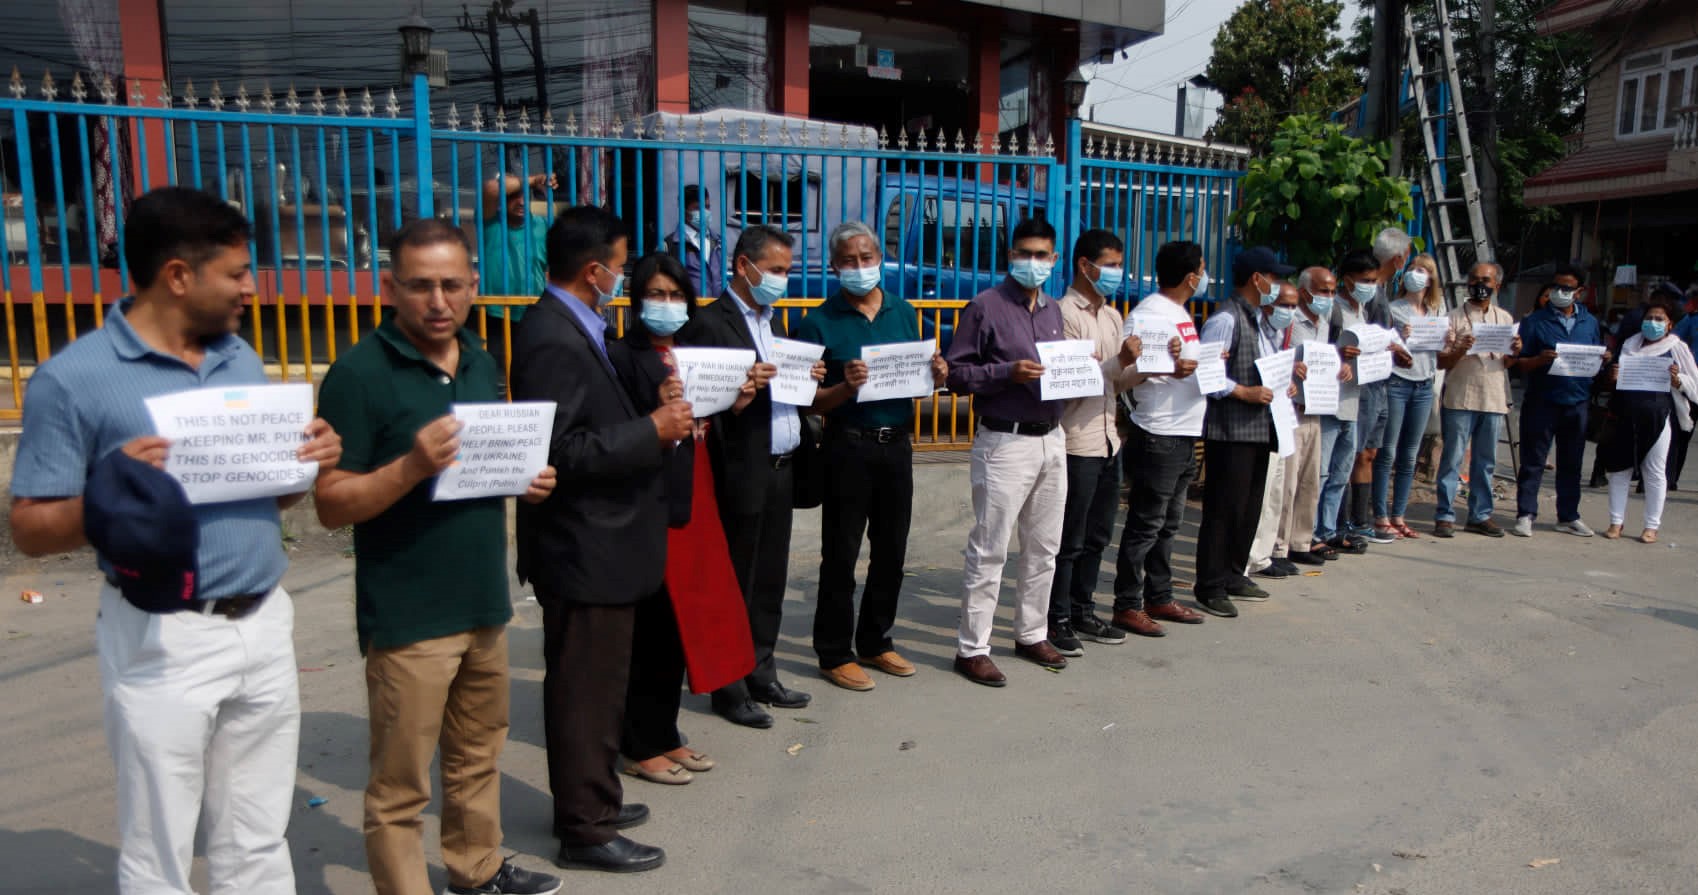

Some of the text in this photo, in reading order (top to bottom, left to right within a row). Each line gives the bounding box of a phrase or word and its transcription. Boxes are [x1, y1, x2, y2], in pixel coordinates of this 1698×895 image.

[680, 360, 699, 369] STOP
[700, 361, 717, 369] WAR
[718, 362, 725, 371] IN
[698, 373, 738, 382] IMMEDIATELY
[479, 407, 540, 419] DEAR RUSSIAN
[176, 412, 305, 428] THIS IS NOT PEACE
[507, 423, 539, 433] PLEASE
[183, 433, 244, 448] KEEPING
[248, 432, 271, 444] MR.
[461, 437, 543, 449] HELP BRING PEACE
[175, 453, 209, 466] THIS
[213, 453, 227, 465] IS
[472, 452, 481, 461] IN
[181, 468, 305, 484] STOP GENOCIDES
[460, 466, 478, 475] And
[512, 465, 526, 474] the
